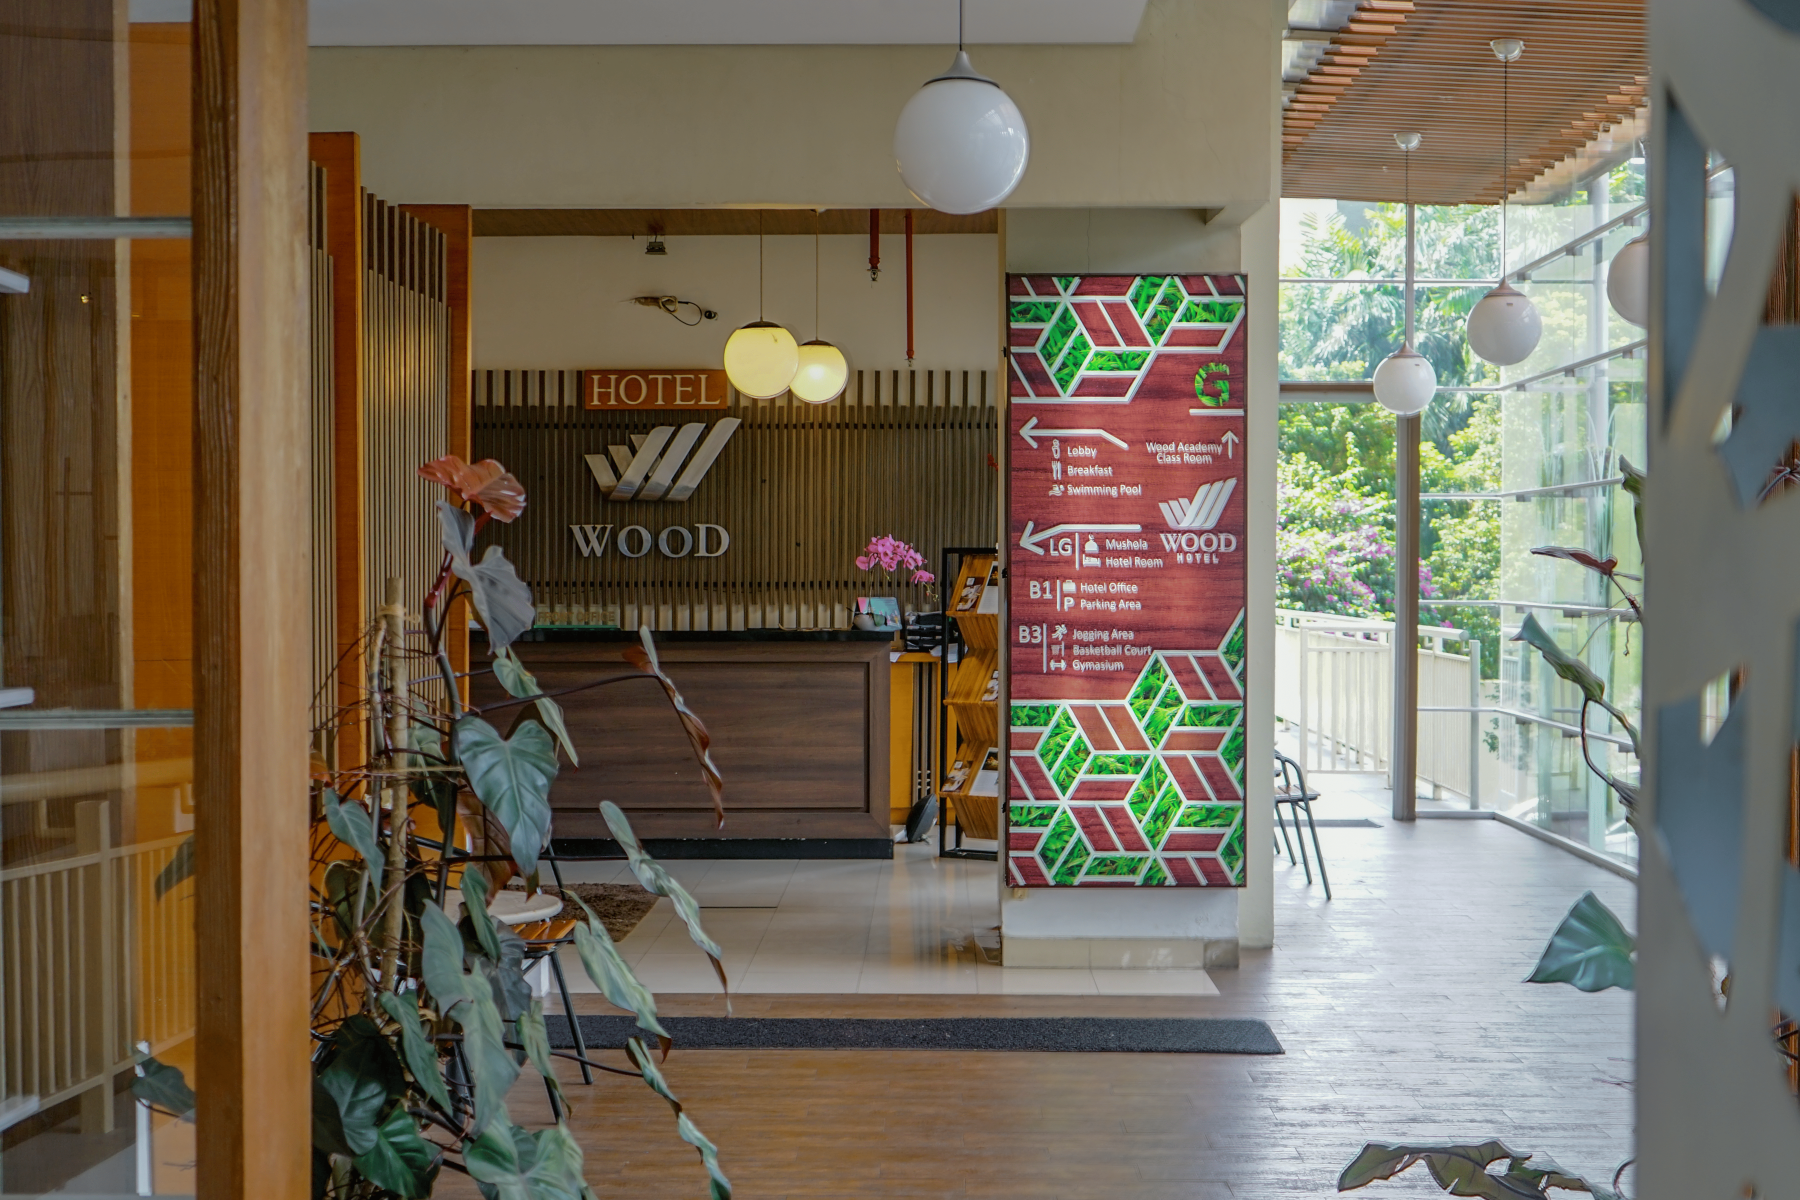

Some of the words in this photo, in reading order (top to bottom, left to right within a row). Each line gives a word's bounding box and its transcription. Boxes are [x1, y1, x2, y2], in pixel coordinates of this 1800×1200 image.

[590, 374, 723, 405] HOTEL
[1067, 446, 1097, 459] Lobby
[1146, 442, 1175, 453] Wood
[1177, 442, 1223, 455] Academy
[1156, 453, 1180, 463] Class
[1183, 453, 1212, 463] Room
[1067, 465, 1113, 476] Breakfast
[1067, 484, 1118, 497] Swimming
[1119, 484, 1142, 496] Pool
[569, 523, 730, 558] WOOD
[1105, 538, 1148, 551] Mushola
[1159, 532, 1237, 553] WOOD
[1049, 538, 1073, 557] LG
[1105, 556, 1132, 568] Hotel
[1134, 557, 1163, 568] Room
[1176, 553, 1219, 564] HOTEL
[1029, 580, 1053, 599] B1
[1080, 582, 1107, 593] Hotel
[1108, 582, 1138, 593] Office
[1080, 599, 1117, 611] Parking
[1118, 599, 1141, 610] Area
[537, 611, 574, 622] FRONT
[576, 611, 615, 622] OFFICE
[1018, 626, 1042, 644] B3
[1072, 629, 1109, 641] Jogging
[1111, 629, 1134, 640] Area
[1072, 645, 1122, 656] Basketball
[1124, 645, 1152, 656] Court
